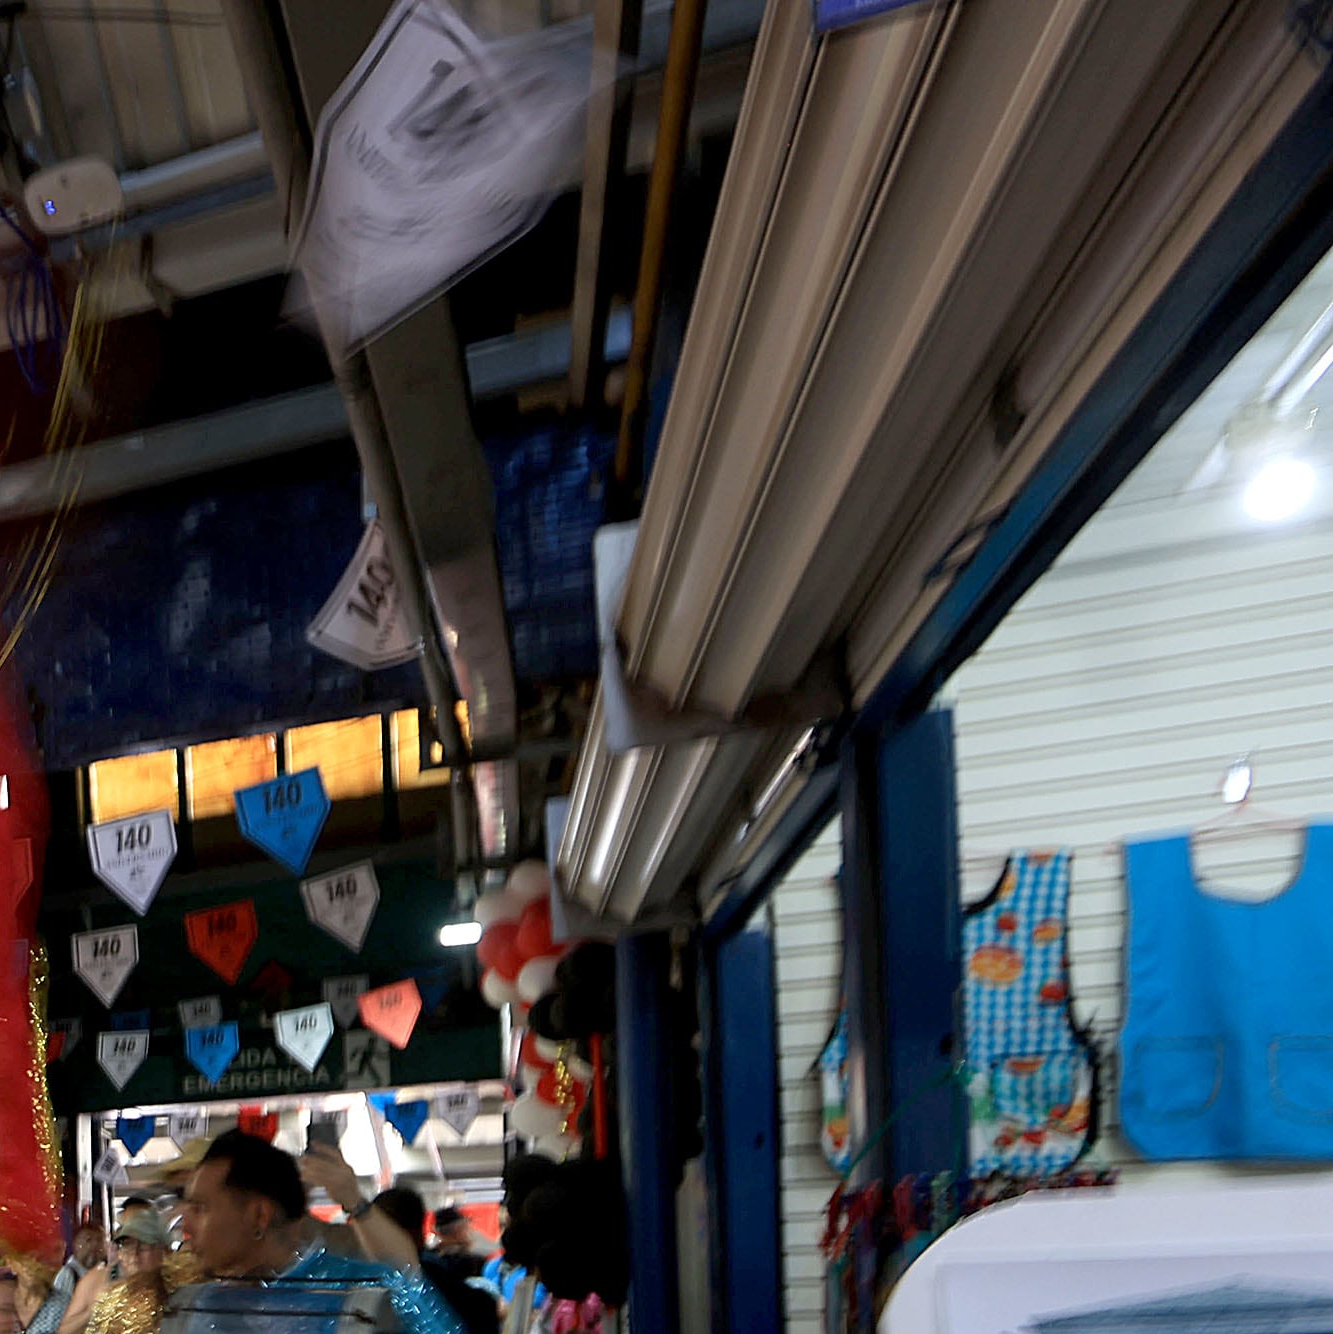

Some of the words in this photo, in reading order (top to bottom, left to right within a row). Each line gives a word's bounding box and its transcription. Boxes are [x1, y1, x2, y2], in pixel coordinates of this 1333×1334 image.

[262, 783, 301, 813] 140
[115, 824, 151, 852] 140
[94, 937, 120, 957] 140
[294, 1013, 317, 1033] 140
[112, 1039, 136, 1055] 140
